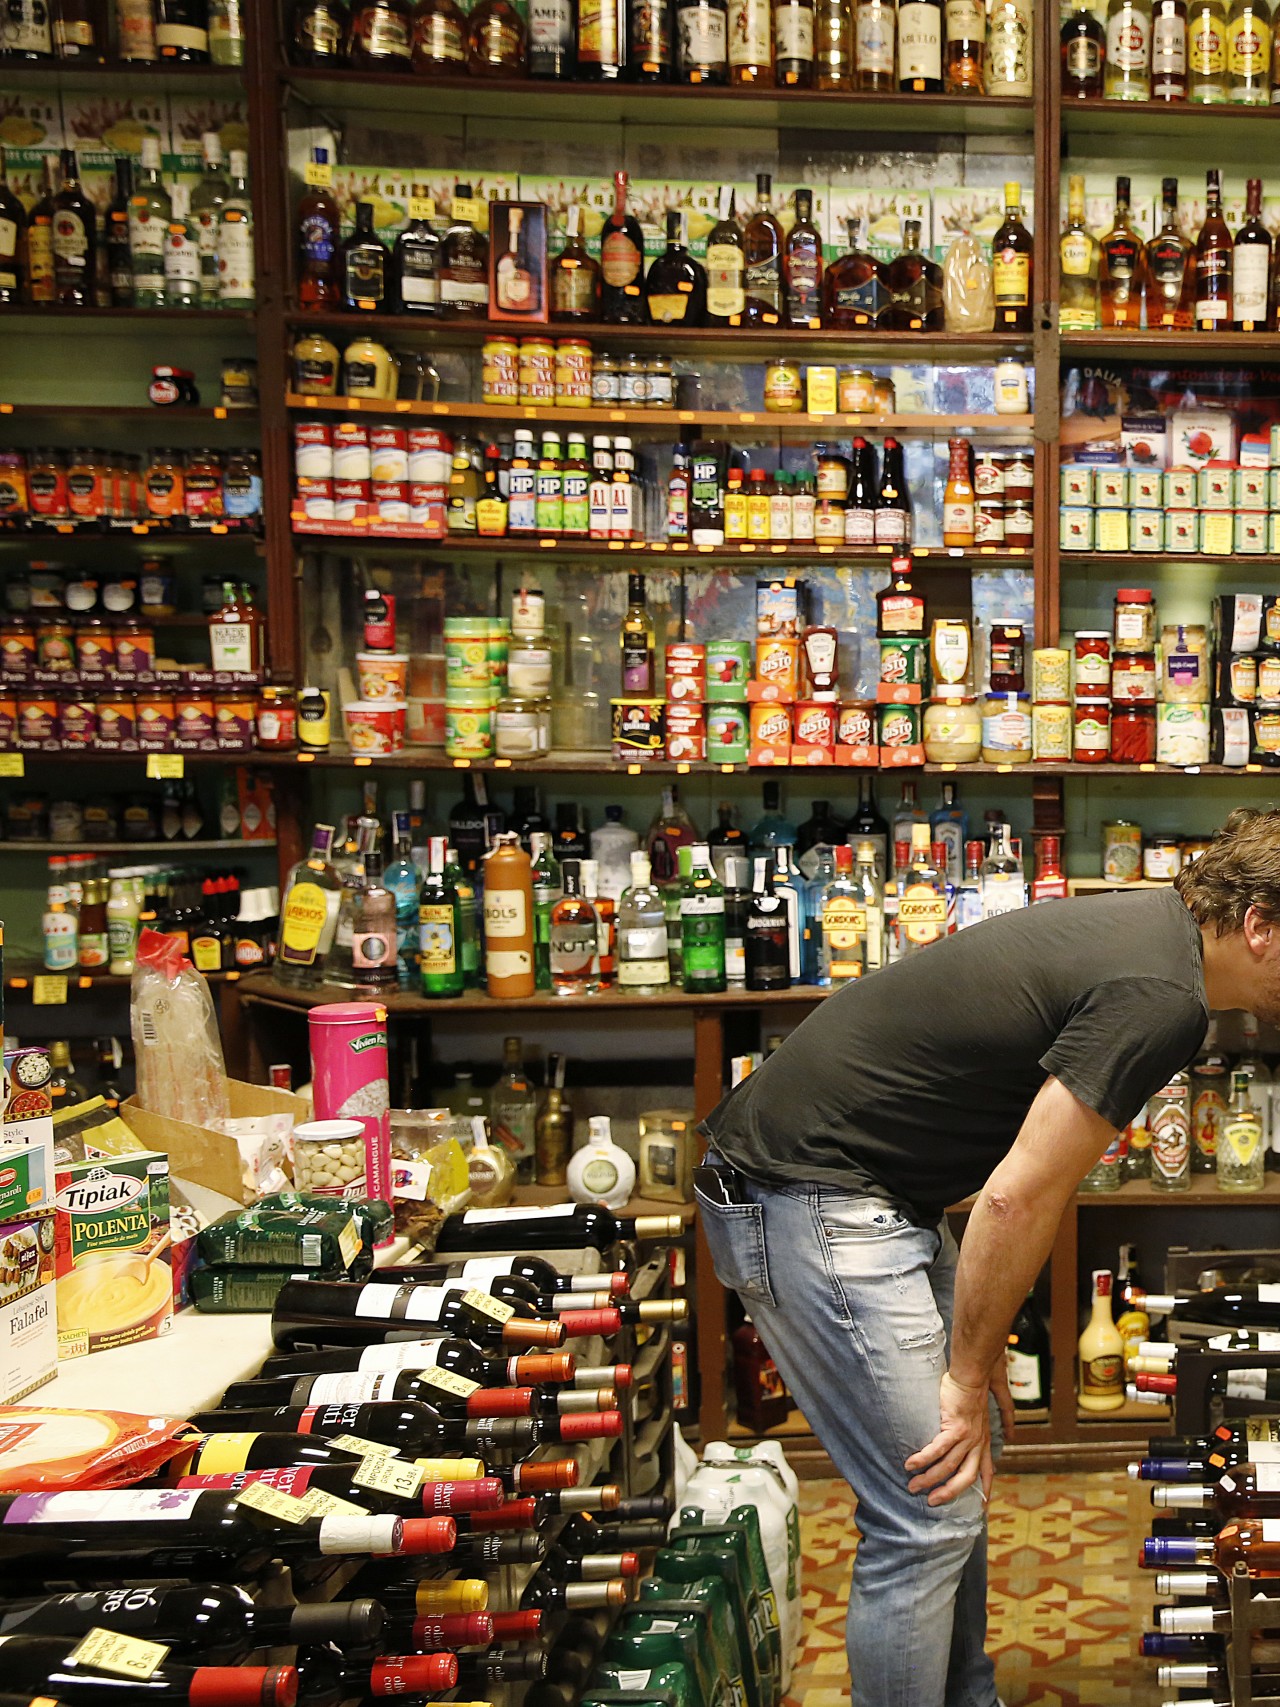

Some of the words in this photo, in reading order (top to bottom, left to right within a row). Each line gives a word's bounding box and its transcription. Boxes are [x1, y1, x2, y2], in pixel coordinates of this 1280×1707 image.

[694, 464, 717, 480] HP
[510, 476, 534, 493] HP
[537, 478, 561, 494] HP
[563, 479, 588, 495] HP
[759, 656, 792, 676] BISTO
[34, 671, 60, 682] Paste
[80, 671, 105, 682] Paste
[111, 671, 136, 681] Paste
[155, 670, 181, 681] Paste
[188, 672, 214, 683] Paste
[233, 672, 258, 682] Paste
[758, 717, 790, 739] BISTO
[798, 717, 831, 739] BISTO
[838, 717, 871, 738] BISTO
[881, 719, 913, 740] BISTO
[16, 739, 42, 750] Paste
[62, 739, 88, 750] Paste
[94, 739, 119, 750] Paste
[139, 739, 165, 750] Paste
[173, 739, 199, 750] Paste
[218, 738, 244, 749] Paste
[550, 938, 589, 955] NUT
[352, 1035, 376, 1052] Vivien
[3, 1127, 24, 1138] Style
[65, 1181, 133, 1211] Tipiak
[73, 1212, 149, 1244] POLENTA
[9, 1306, 49, 1336] Falafel
[163, 1315, 171, 1332] 5
[61, 1330, 88, 1343] SACHETS
[355, 1453, 375, 1484] CATALONIA
[366, 1457, 387, 1486] EMPORDA
[393, 1477, 413, 1491] 13
[434, 1482, 443, 1510] conti
[447, 1482, 456, 1510] oliver
